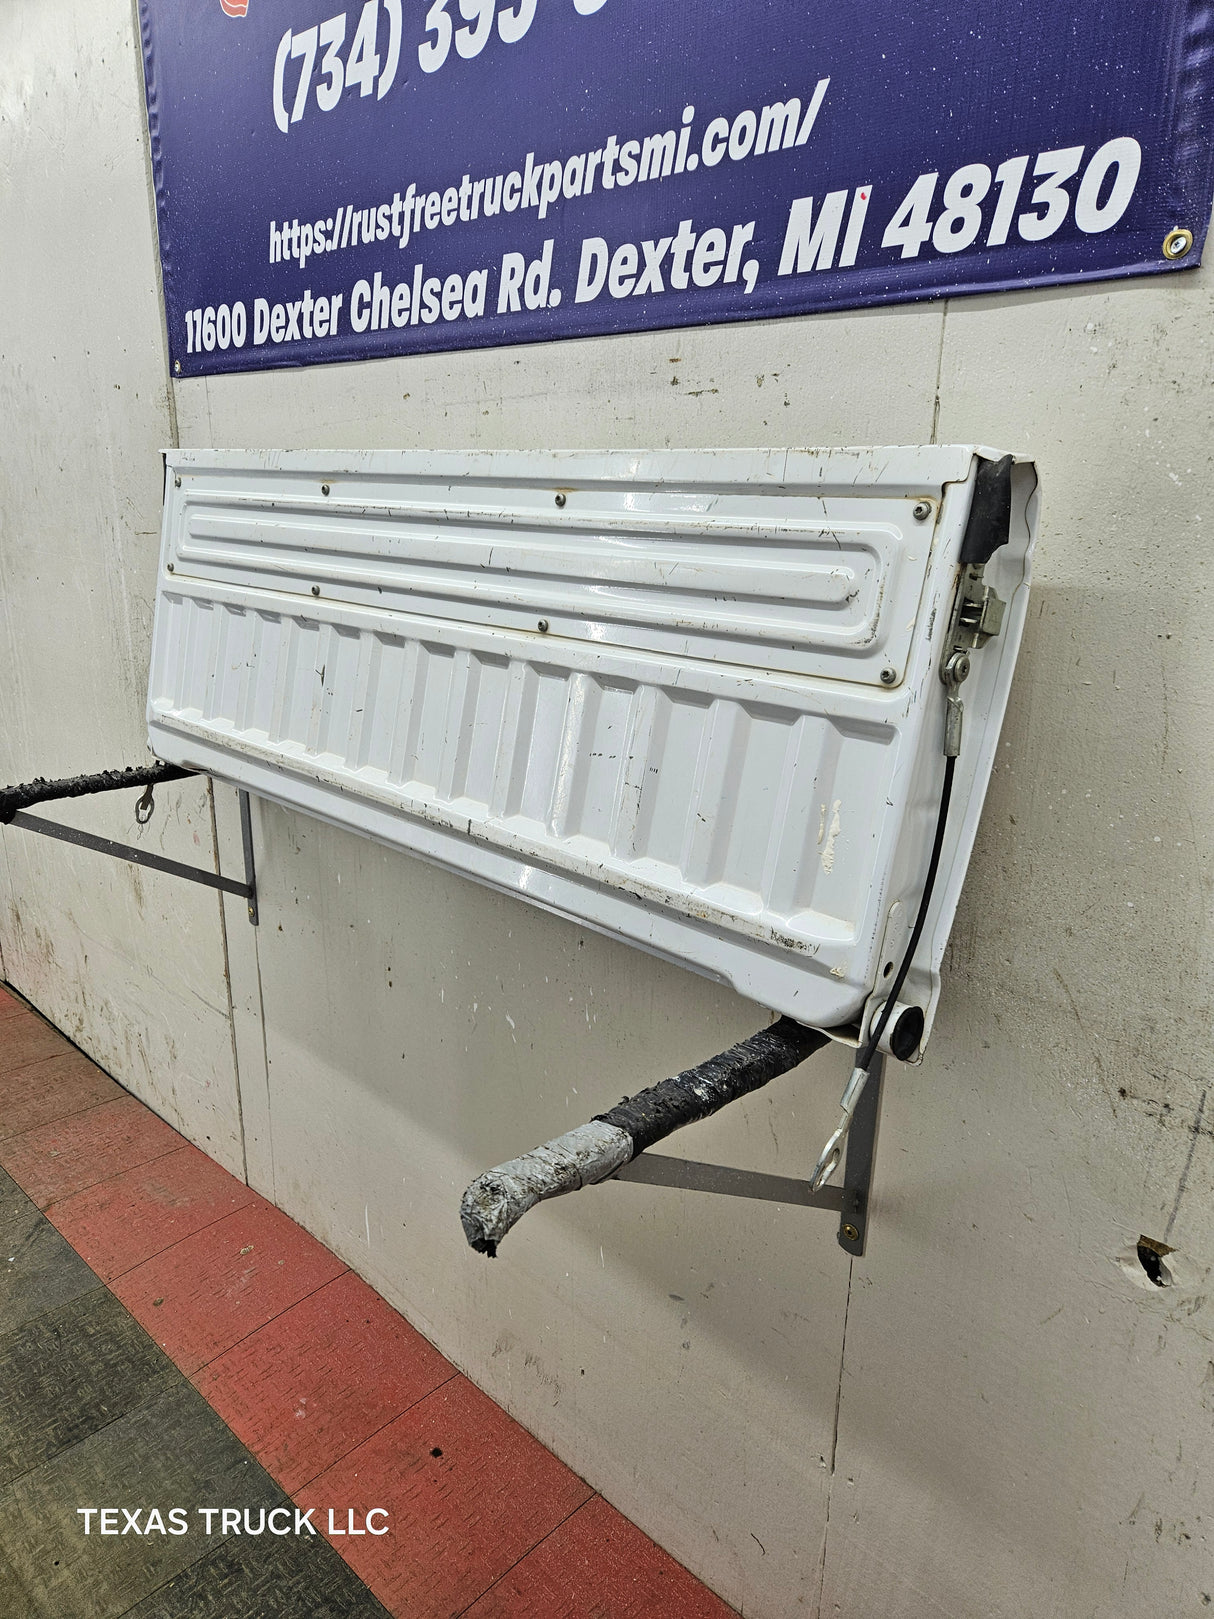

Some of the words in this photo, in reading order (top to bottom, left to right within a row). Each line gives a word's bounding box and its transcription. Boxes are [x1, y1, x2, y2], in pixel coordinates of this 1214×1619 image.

[273, 0, 402, 133] (734)
[185, 302, 247, 353] 11600
[254, 294, 343, 345] Dexter
[351, 264, 488, 332] Chelsea
[497, 239, 561, 314] Rd.
[575, 219, 759, 304] Dexter,
[778, 185, 873, 276] MI
[881, 137, 1141, 259] 48130
[270, 78, 831, 268] https://rustfreetruckpartsmi.com/
